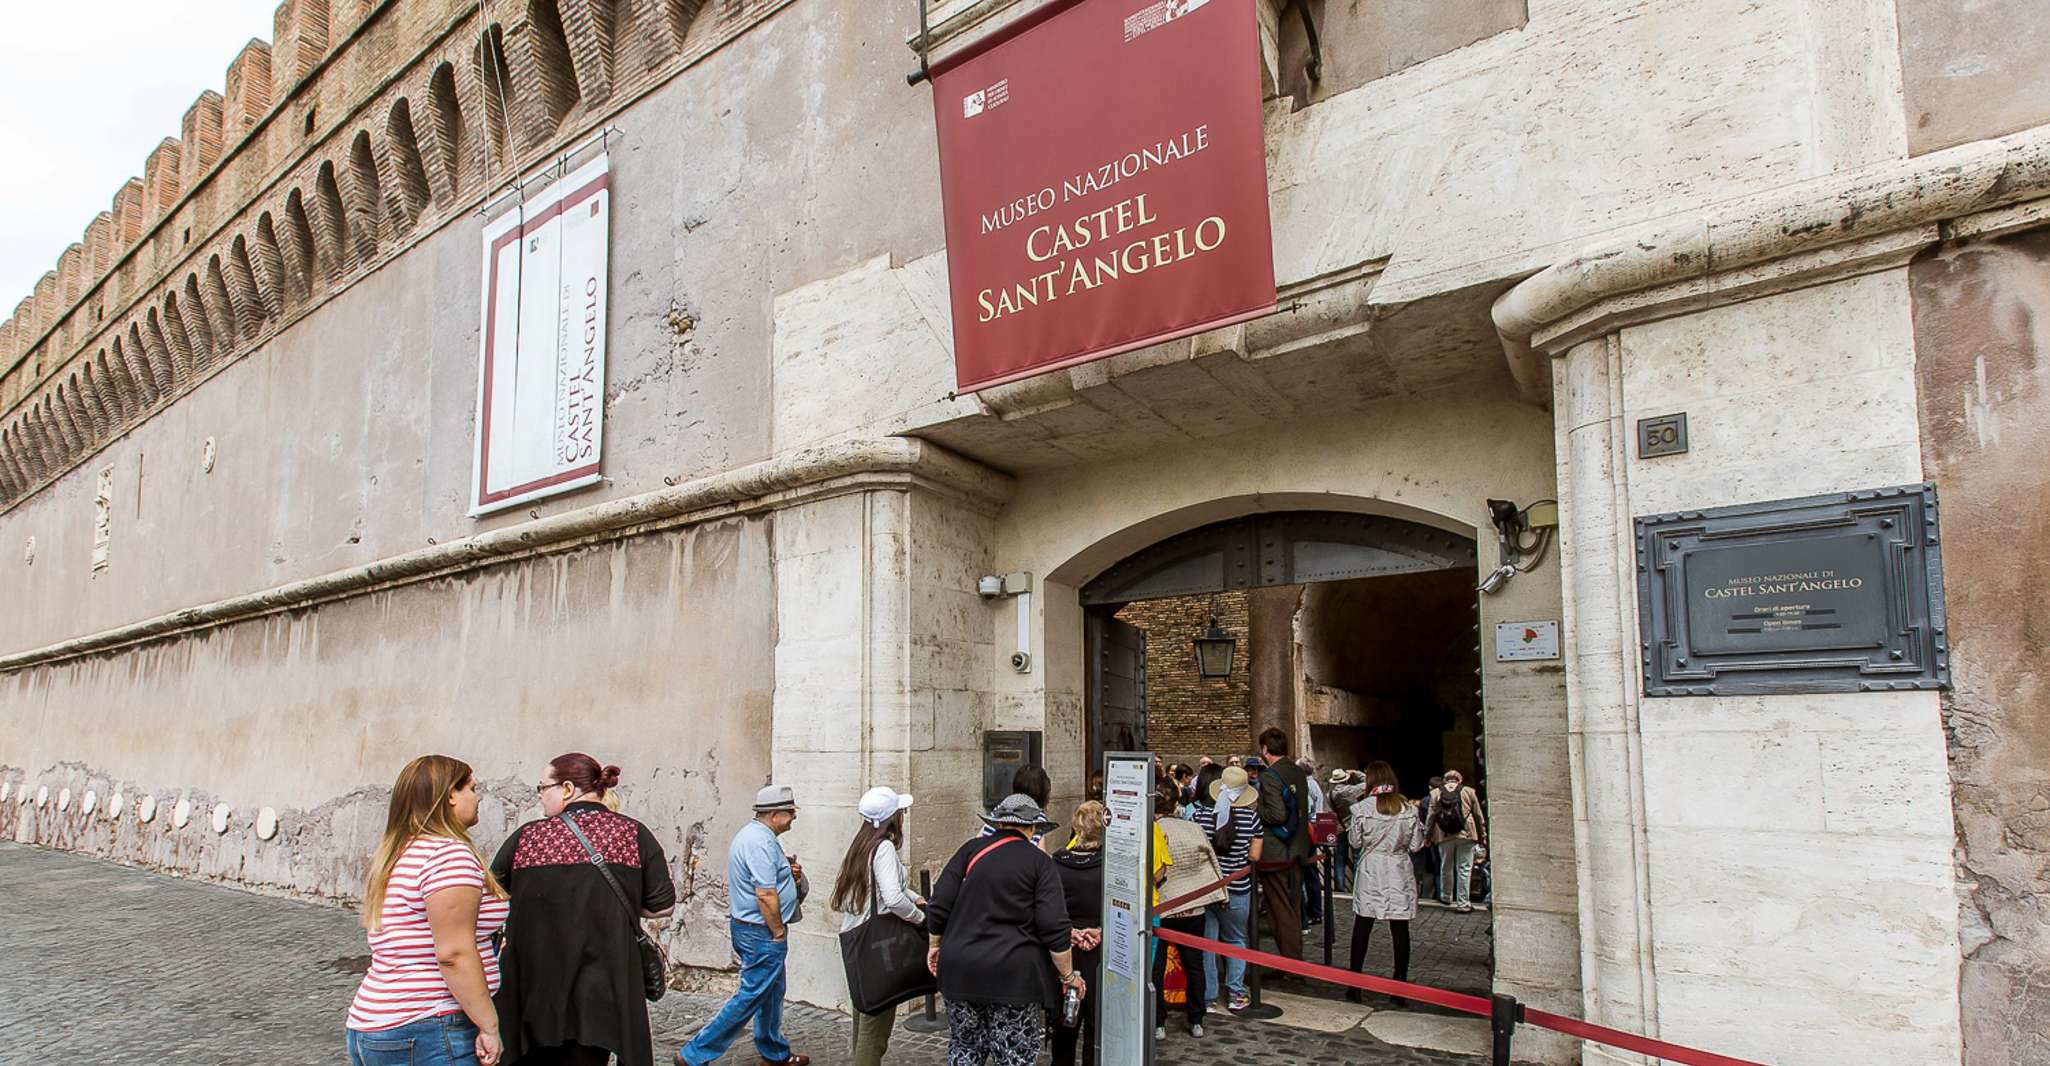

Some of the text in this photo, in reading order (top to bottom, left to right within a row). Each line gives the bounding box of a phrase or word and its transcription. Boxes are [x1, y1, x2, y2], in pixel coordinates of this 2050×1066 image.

[981, 124, 1209, 235] MUSEO NAZIONALE
[1026, 193, 1157, 262] CASTEL
[977, 216, 1226, 323] SANT'ANGELO
[557, 284, 571, 466] MUSEO NAZIONALE DI
[565, 367, 581, 463] CASTEL
[580, 276, 598, 459] SANT'ANGELO
[1646, 427, 1676, 447] 50
[1704, 577, 1863, 599] CASTEL SANT'ANGELO
[1728, 570, 1834, 586] MUSEO NAZIONALE DI
